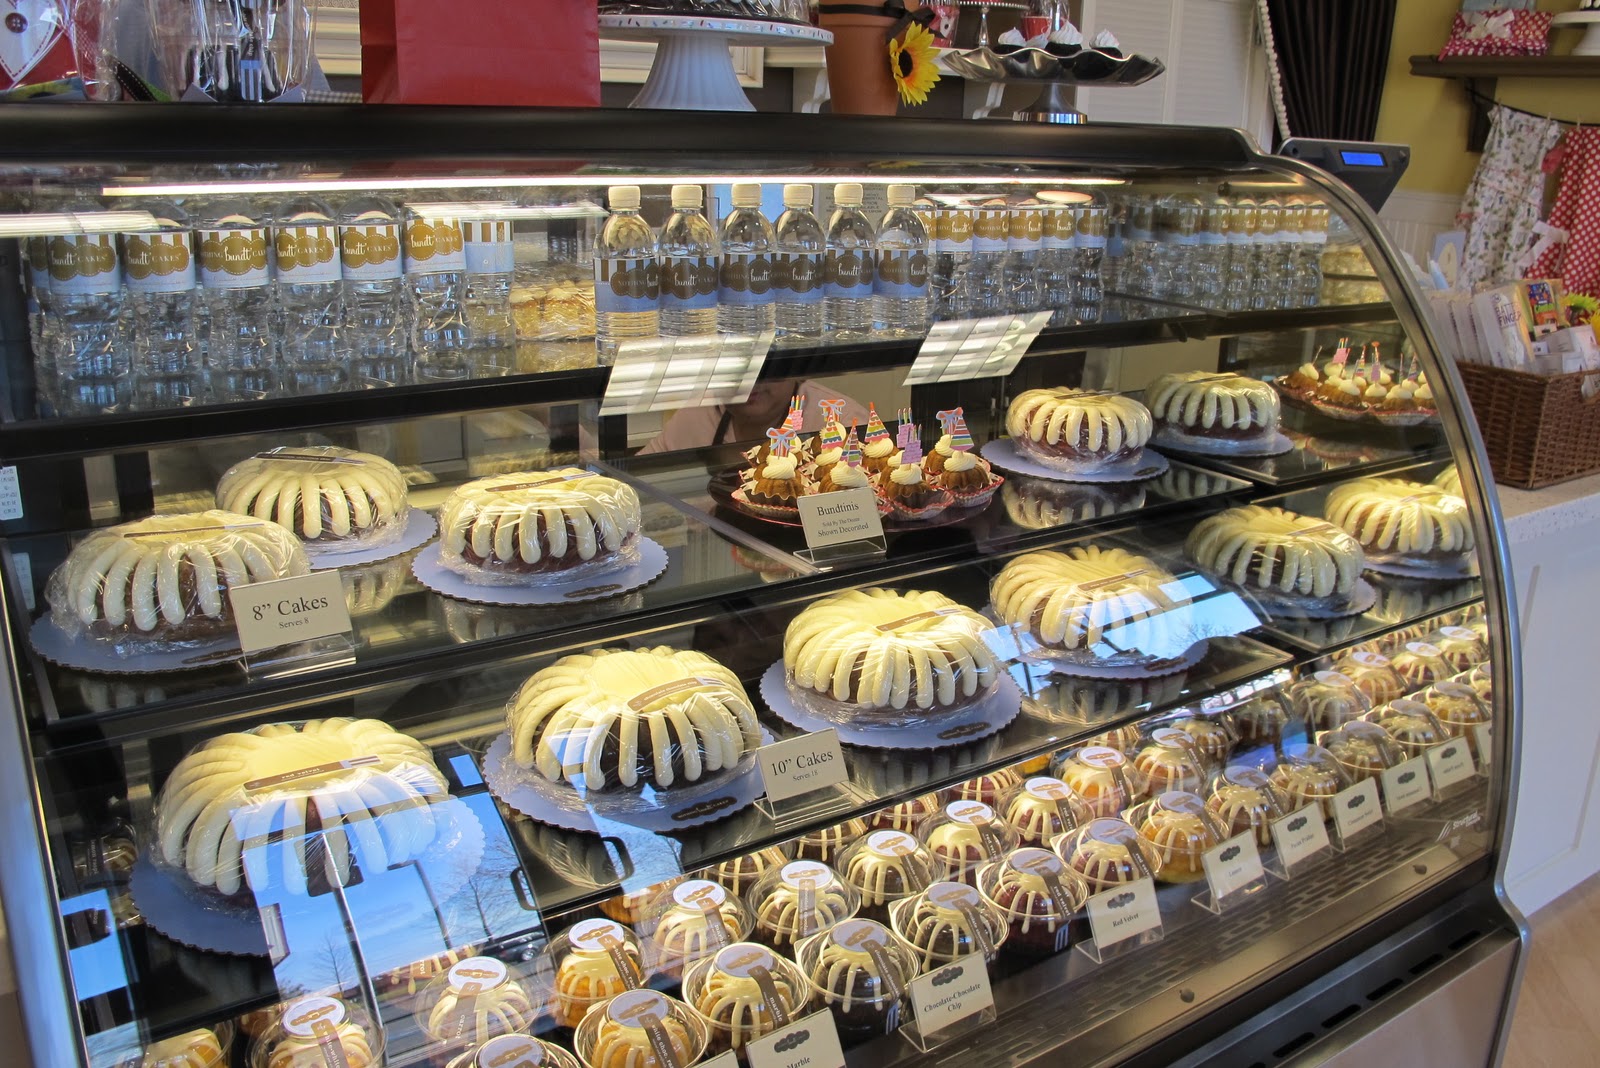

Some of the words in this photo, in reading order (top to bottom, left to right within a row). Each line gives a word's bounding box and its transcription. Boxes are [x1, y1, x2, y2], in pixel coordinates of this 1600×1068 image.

[344, 240, 367, 255] bundt
[411, 234, 435, 248] bundt
[224, 246, 252, 261] bundt
[750, 269, 770, 282] bundt
[792, 268, 816, 281] bundt
[838, 265, 861, 276] bundt
[674, 272, 698, 286] bundt
[817, 501, 859, 516] Bundtinis
[817, 527, 838, 537] Shown
[839, 522, 869, 534] Decorated
[277, 596, 329, 616] Cakes
[279, 618, 304, 629] Serves
[796, 750, 834, 769] Cakes
[793, 773, 811, 781] Serves
[811, 769, 818, 777] 18
[1135, 853, 1143, 863] red
[1054, 885, 1062, 899] red
[1059, 898, 1071, 917] velvet
[1112, 919, 1123, 928] Red
[1124, 912, 1139, 923] Velvet
[924, 983, 981, 1013] Chocolate-Chocolate
[769, 996, 783, 1022] marble
[947, 1002, 962, 1013] Chip
[455, 1014, 466, 1040] carrot
[651, 1024, 661, 1040] white
